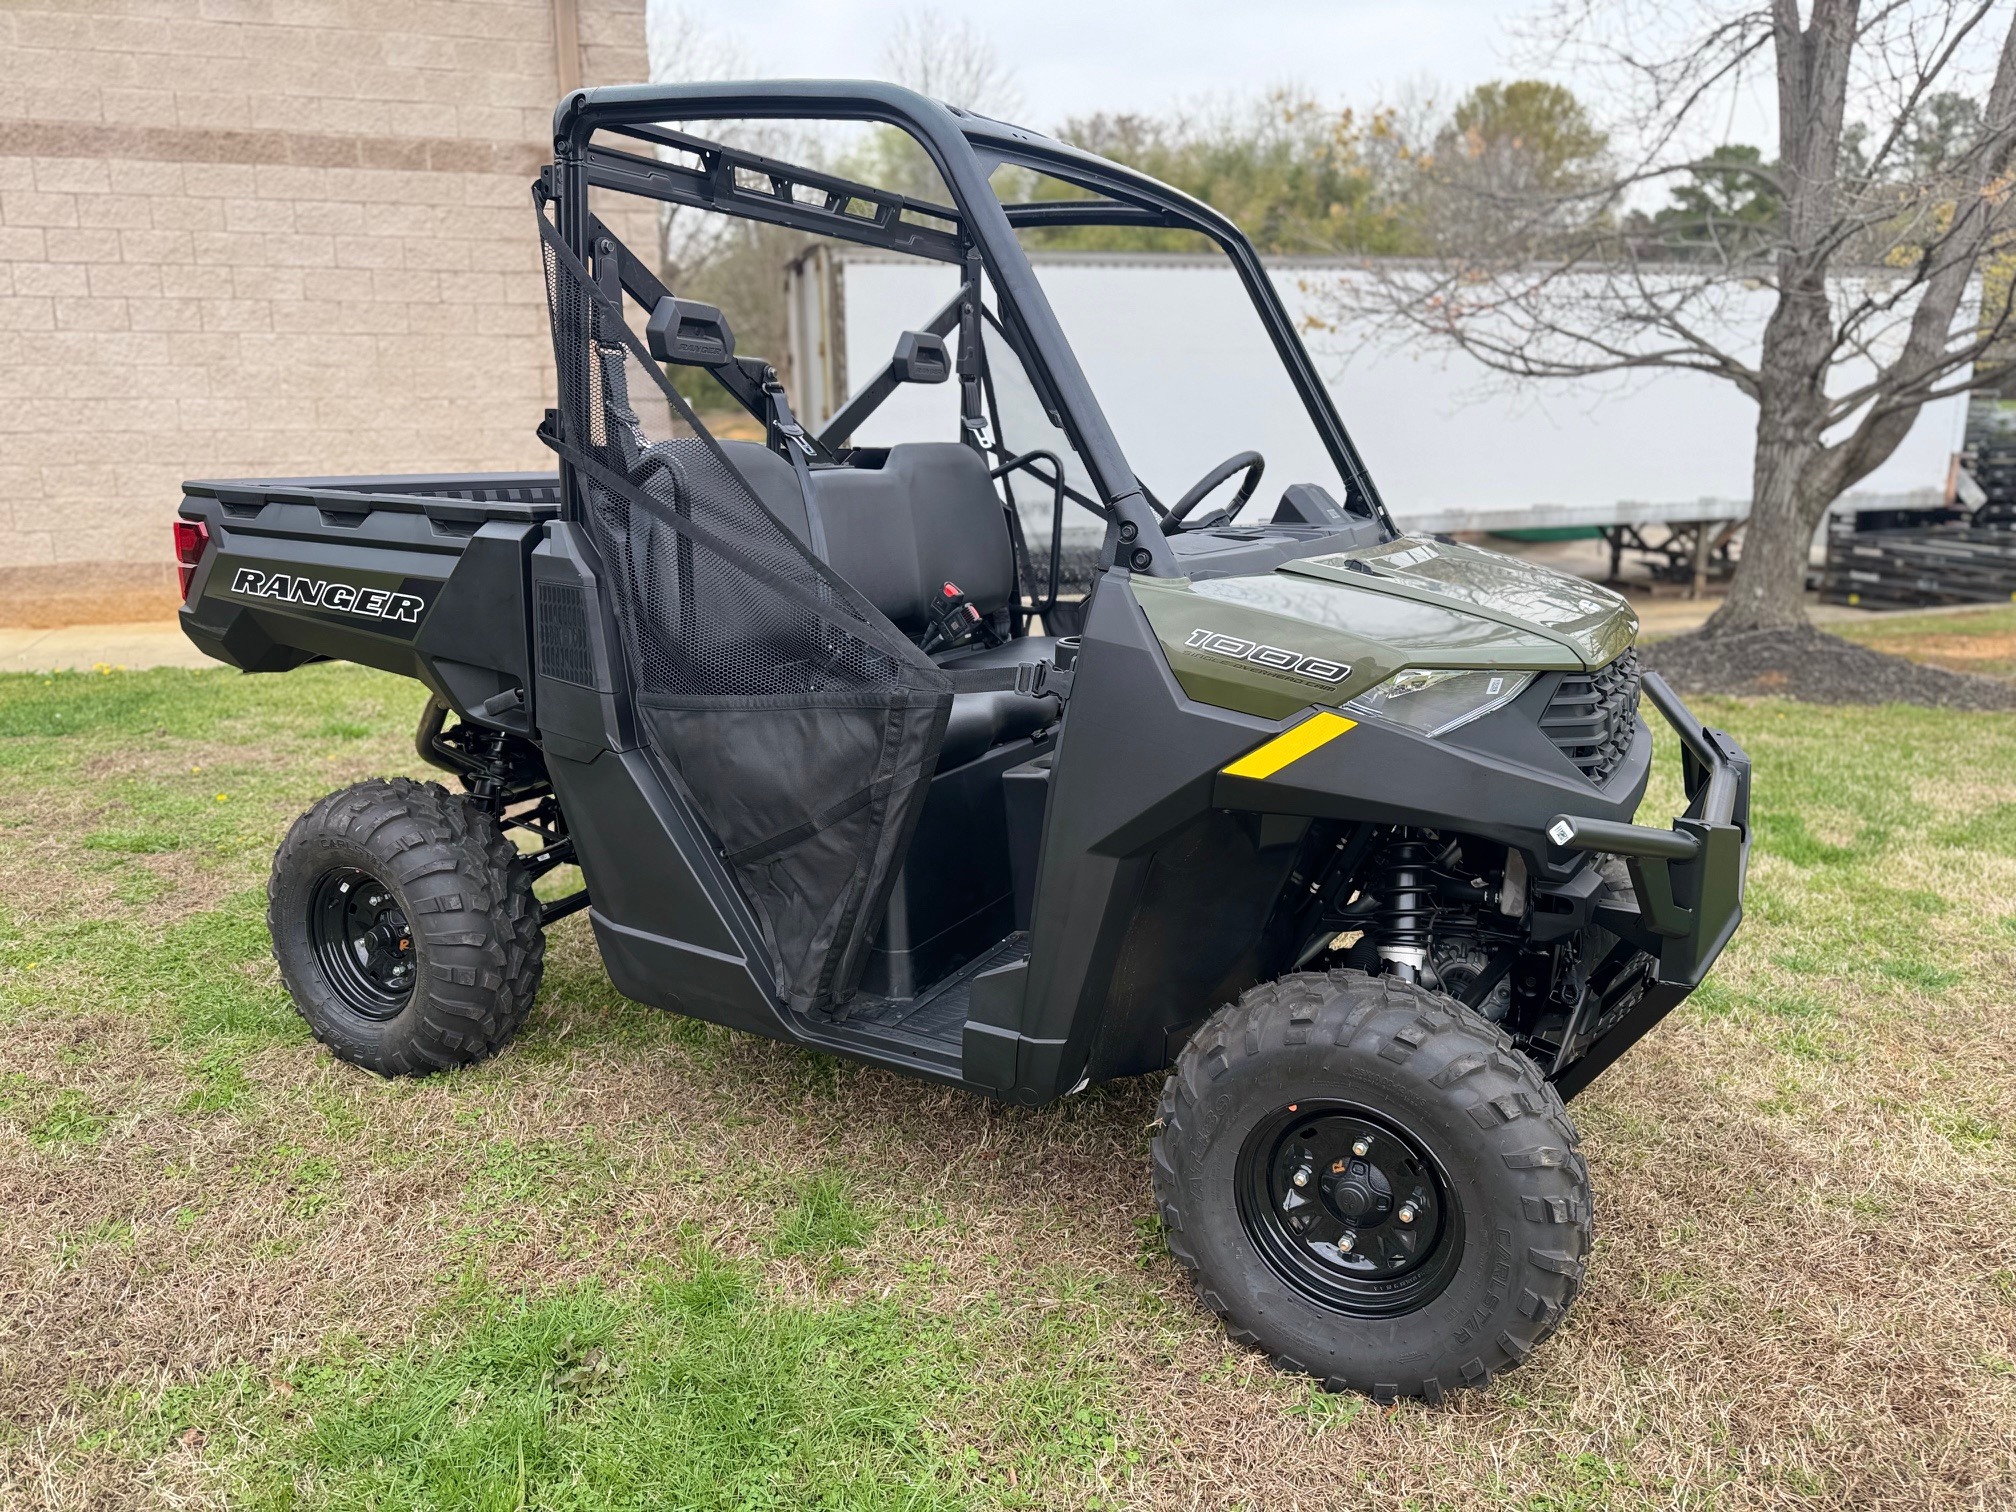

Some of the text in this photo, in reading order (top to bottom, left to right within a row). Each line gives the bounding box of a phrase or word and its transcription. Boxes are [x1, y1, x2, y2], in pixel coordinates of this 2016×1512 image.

[679, 343, 722, 355] RANGER
[231, 568, 425, 623] RANGER
[1184, 628, 1353, 684] 1000
[1232, 663, 1304, 684] OVERHEAD
[1304, 681, 1337, 692] CAM
[1450, 1227, 1512, 1346] CARLSTAR
